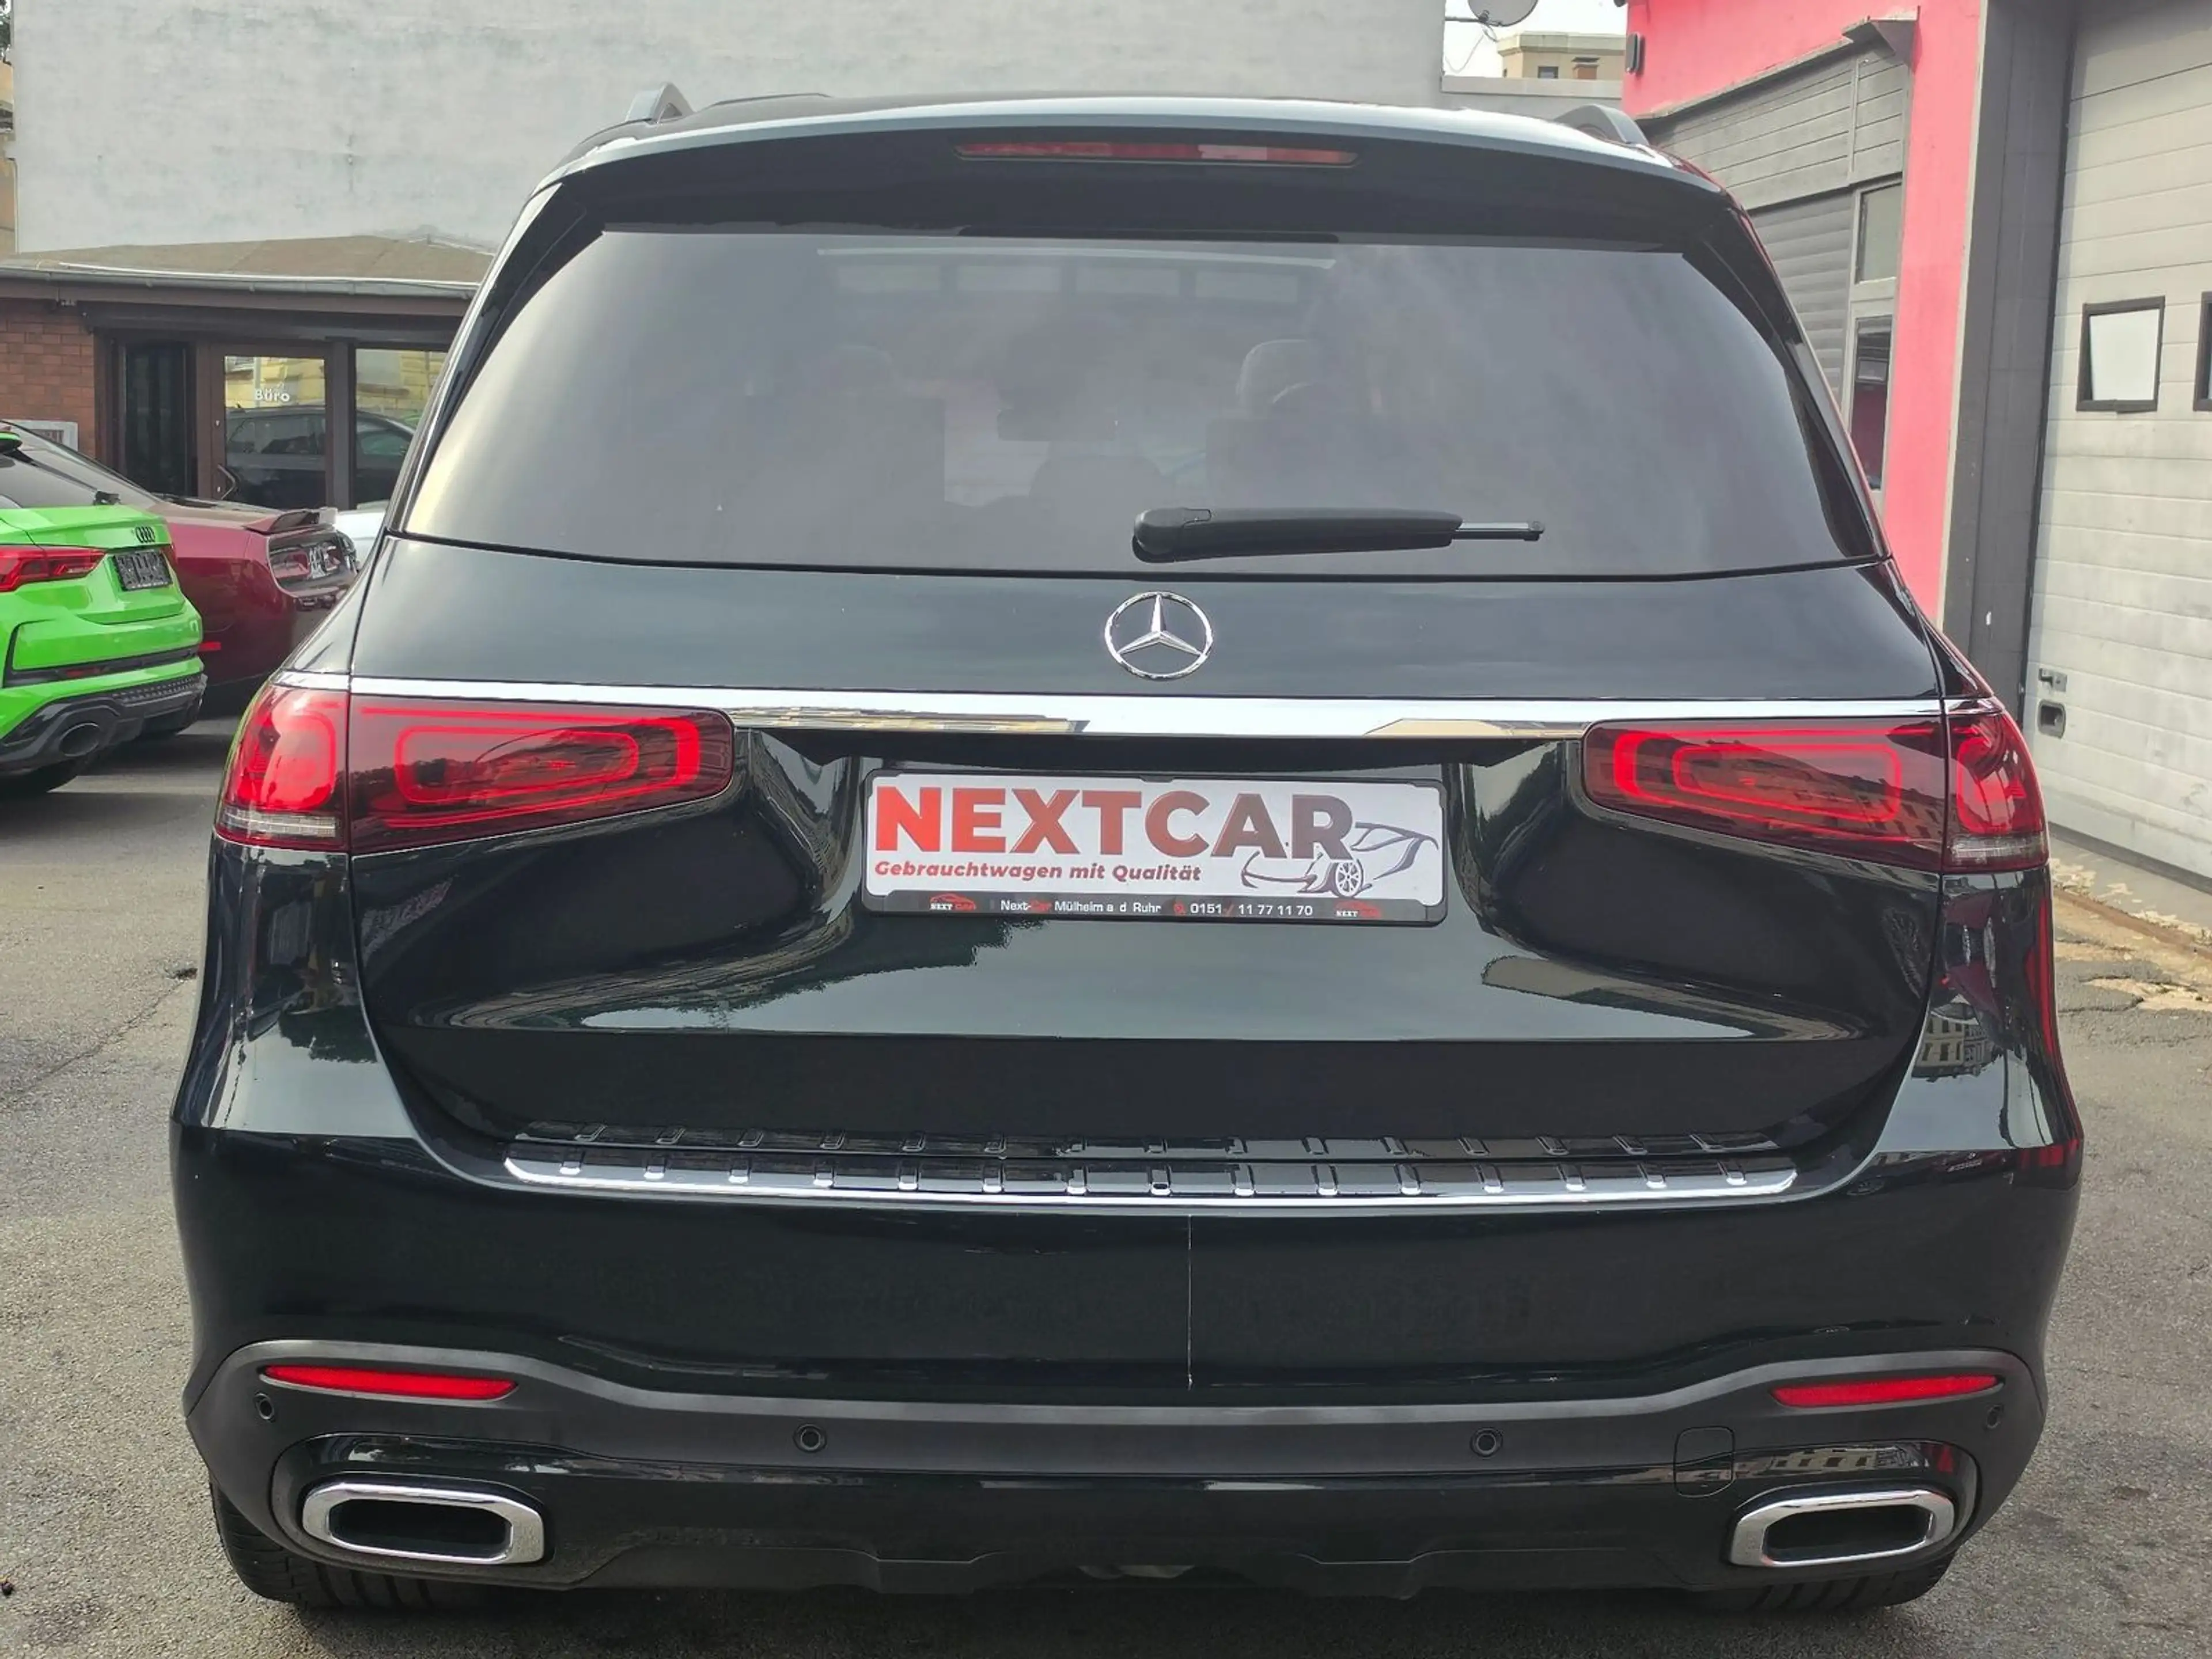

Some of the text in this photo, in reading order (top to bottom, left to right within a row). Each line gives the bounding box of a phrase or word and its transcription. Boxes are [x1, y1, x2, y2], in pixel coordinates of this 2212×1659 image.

[255, 388, 290, 402] Büro
[875, 787, 1354, 859] NEXTCAR
[875, 861, 1202, 882] Gebrauchtwagen mit Qualität
[1055, 901, 1103, 912] Mülheim
[1133, 902, 1161, 913] Ruhr
[1190, 903, 1222, 914] 0151
